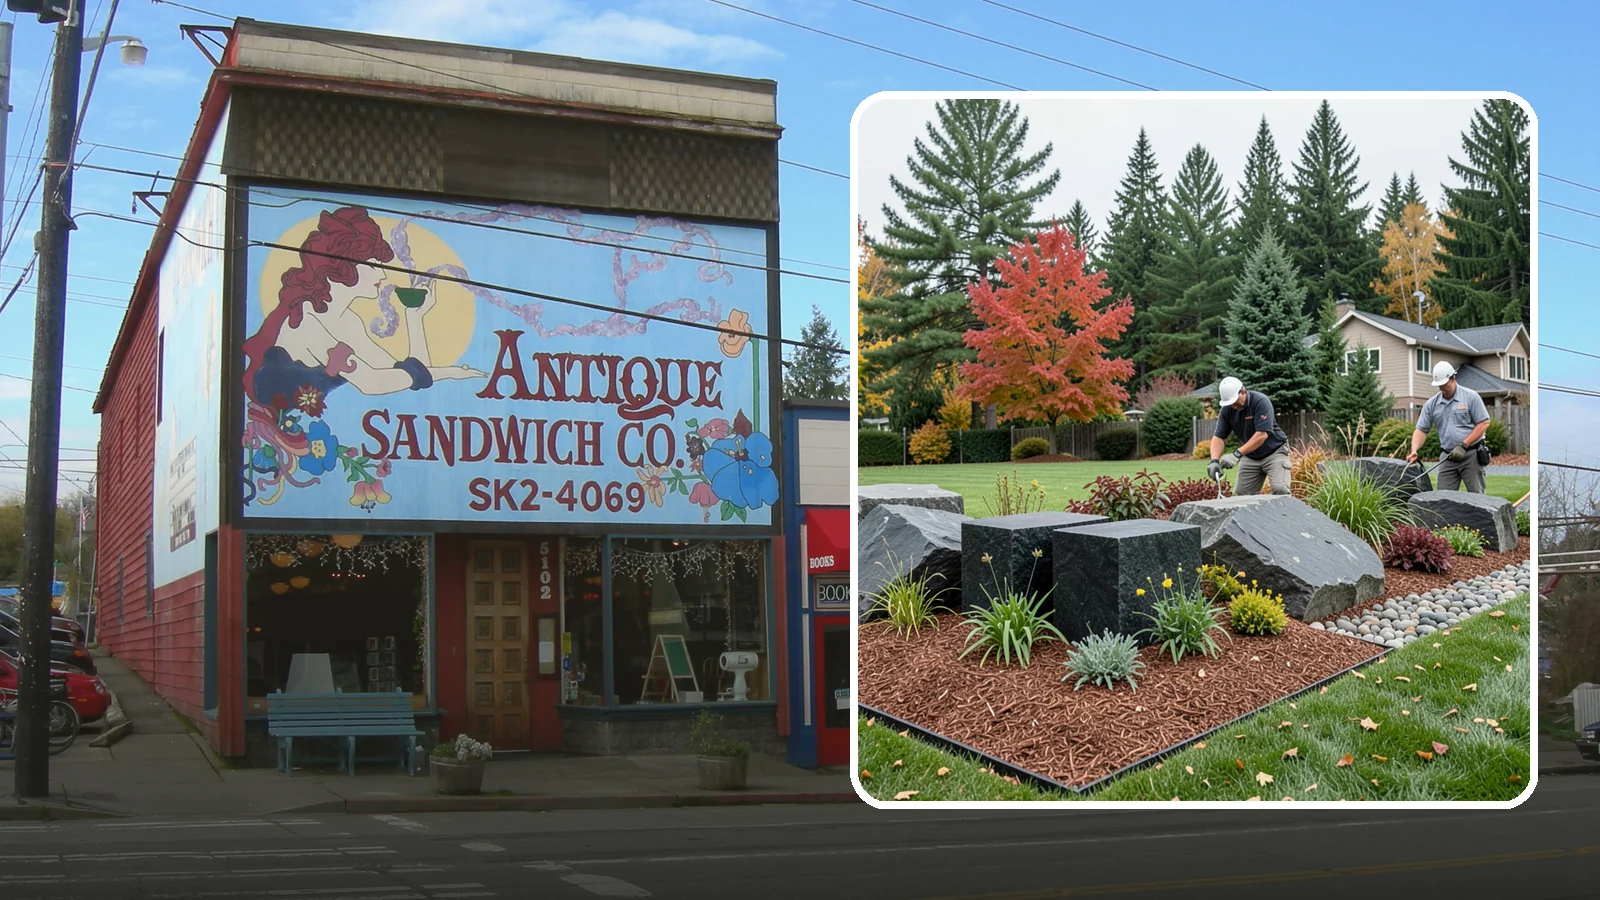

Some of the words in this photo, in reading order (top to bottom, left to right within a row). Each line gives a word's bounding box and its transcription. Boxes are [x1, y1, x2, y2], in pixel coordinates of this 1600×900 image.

[475, 328, 724, 421] ANTIQUE
[361, 408, 605, 468] SANDWICH
[617, 421, 685, 469] CO.
[468, 477, 646, 513] SK2-4069
[539, 541, 552, 600] 5102
[809, 555, 835, 569] BOOKS
